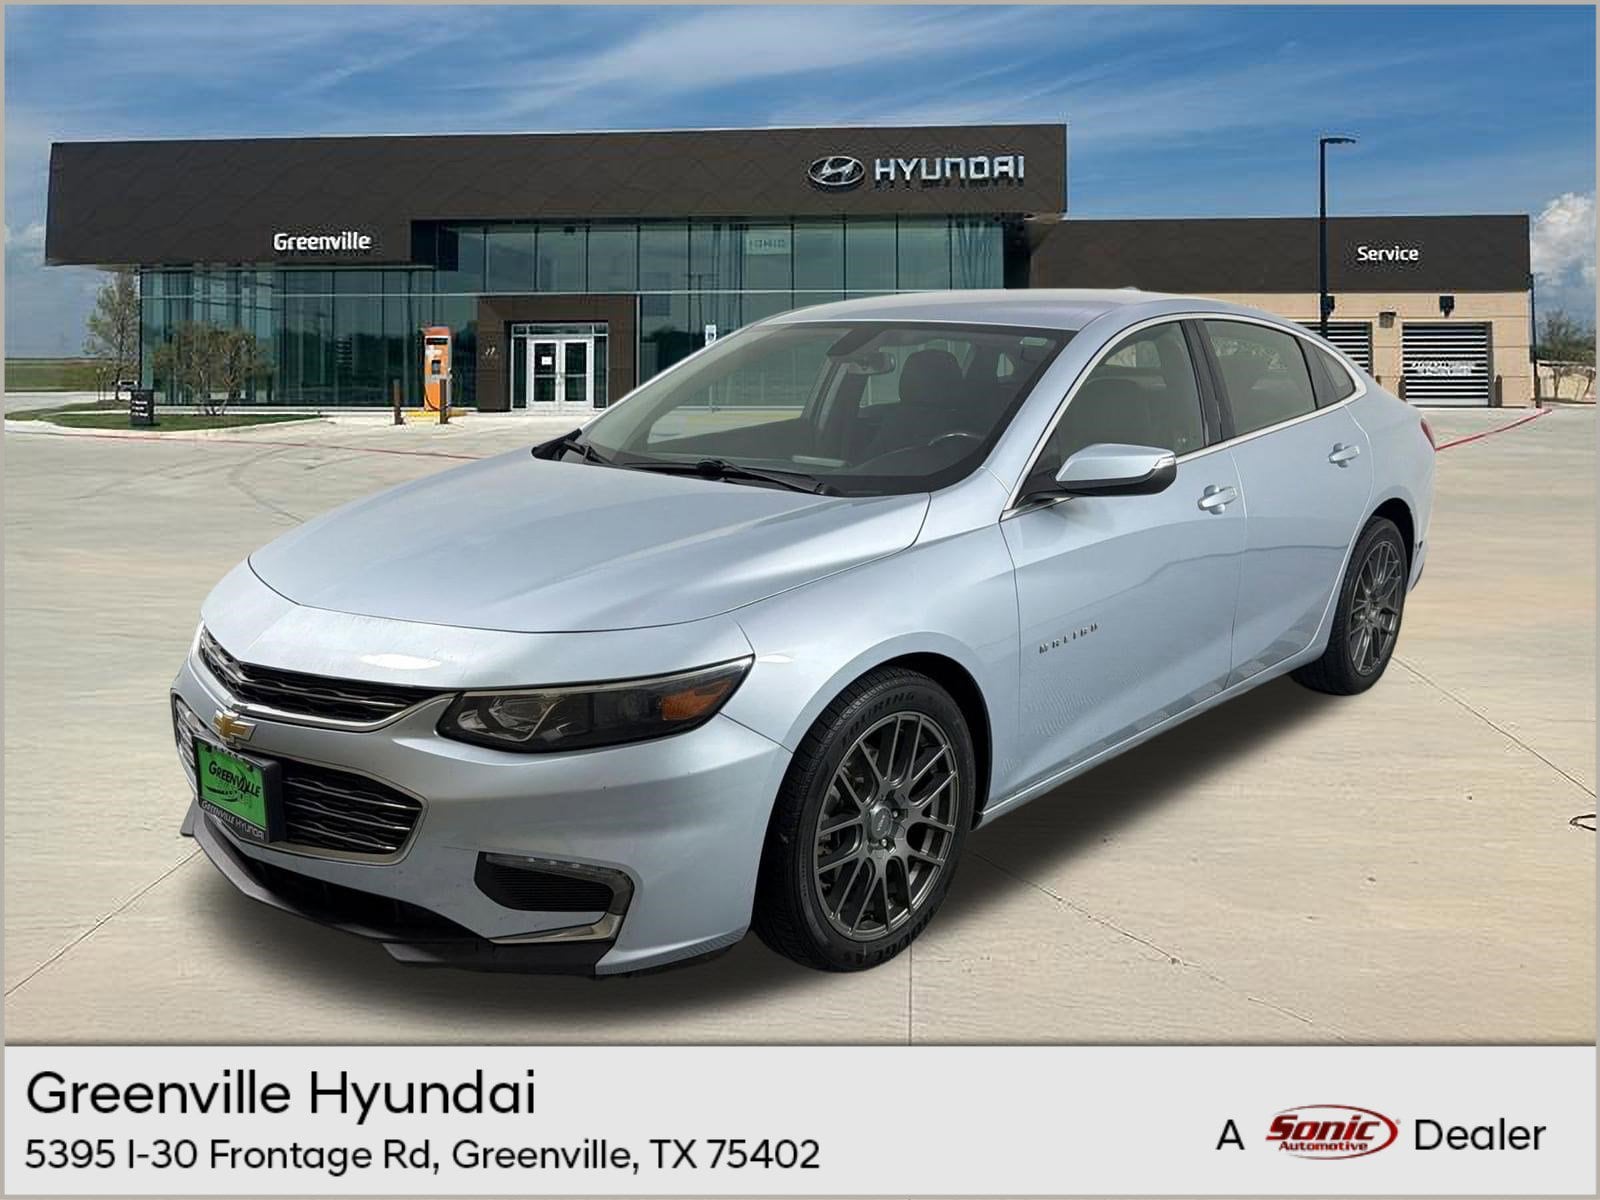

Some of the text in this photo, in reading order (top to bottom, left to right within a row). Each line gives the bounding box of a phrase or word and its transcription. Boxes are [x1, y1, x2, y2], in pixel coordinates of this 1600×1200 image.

[874, 155, 1025, 181] HYUNDAI
[273, 231, 372, 251] Greenville
[1356, 245, 1420, 261] Service
[1039, 622, 1098, 654] MALIBU
